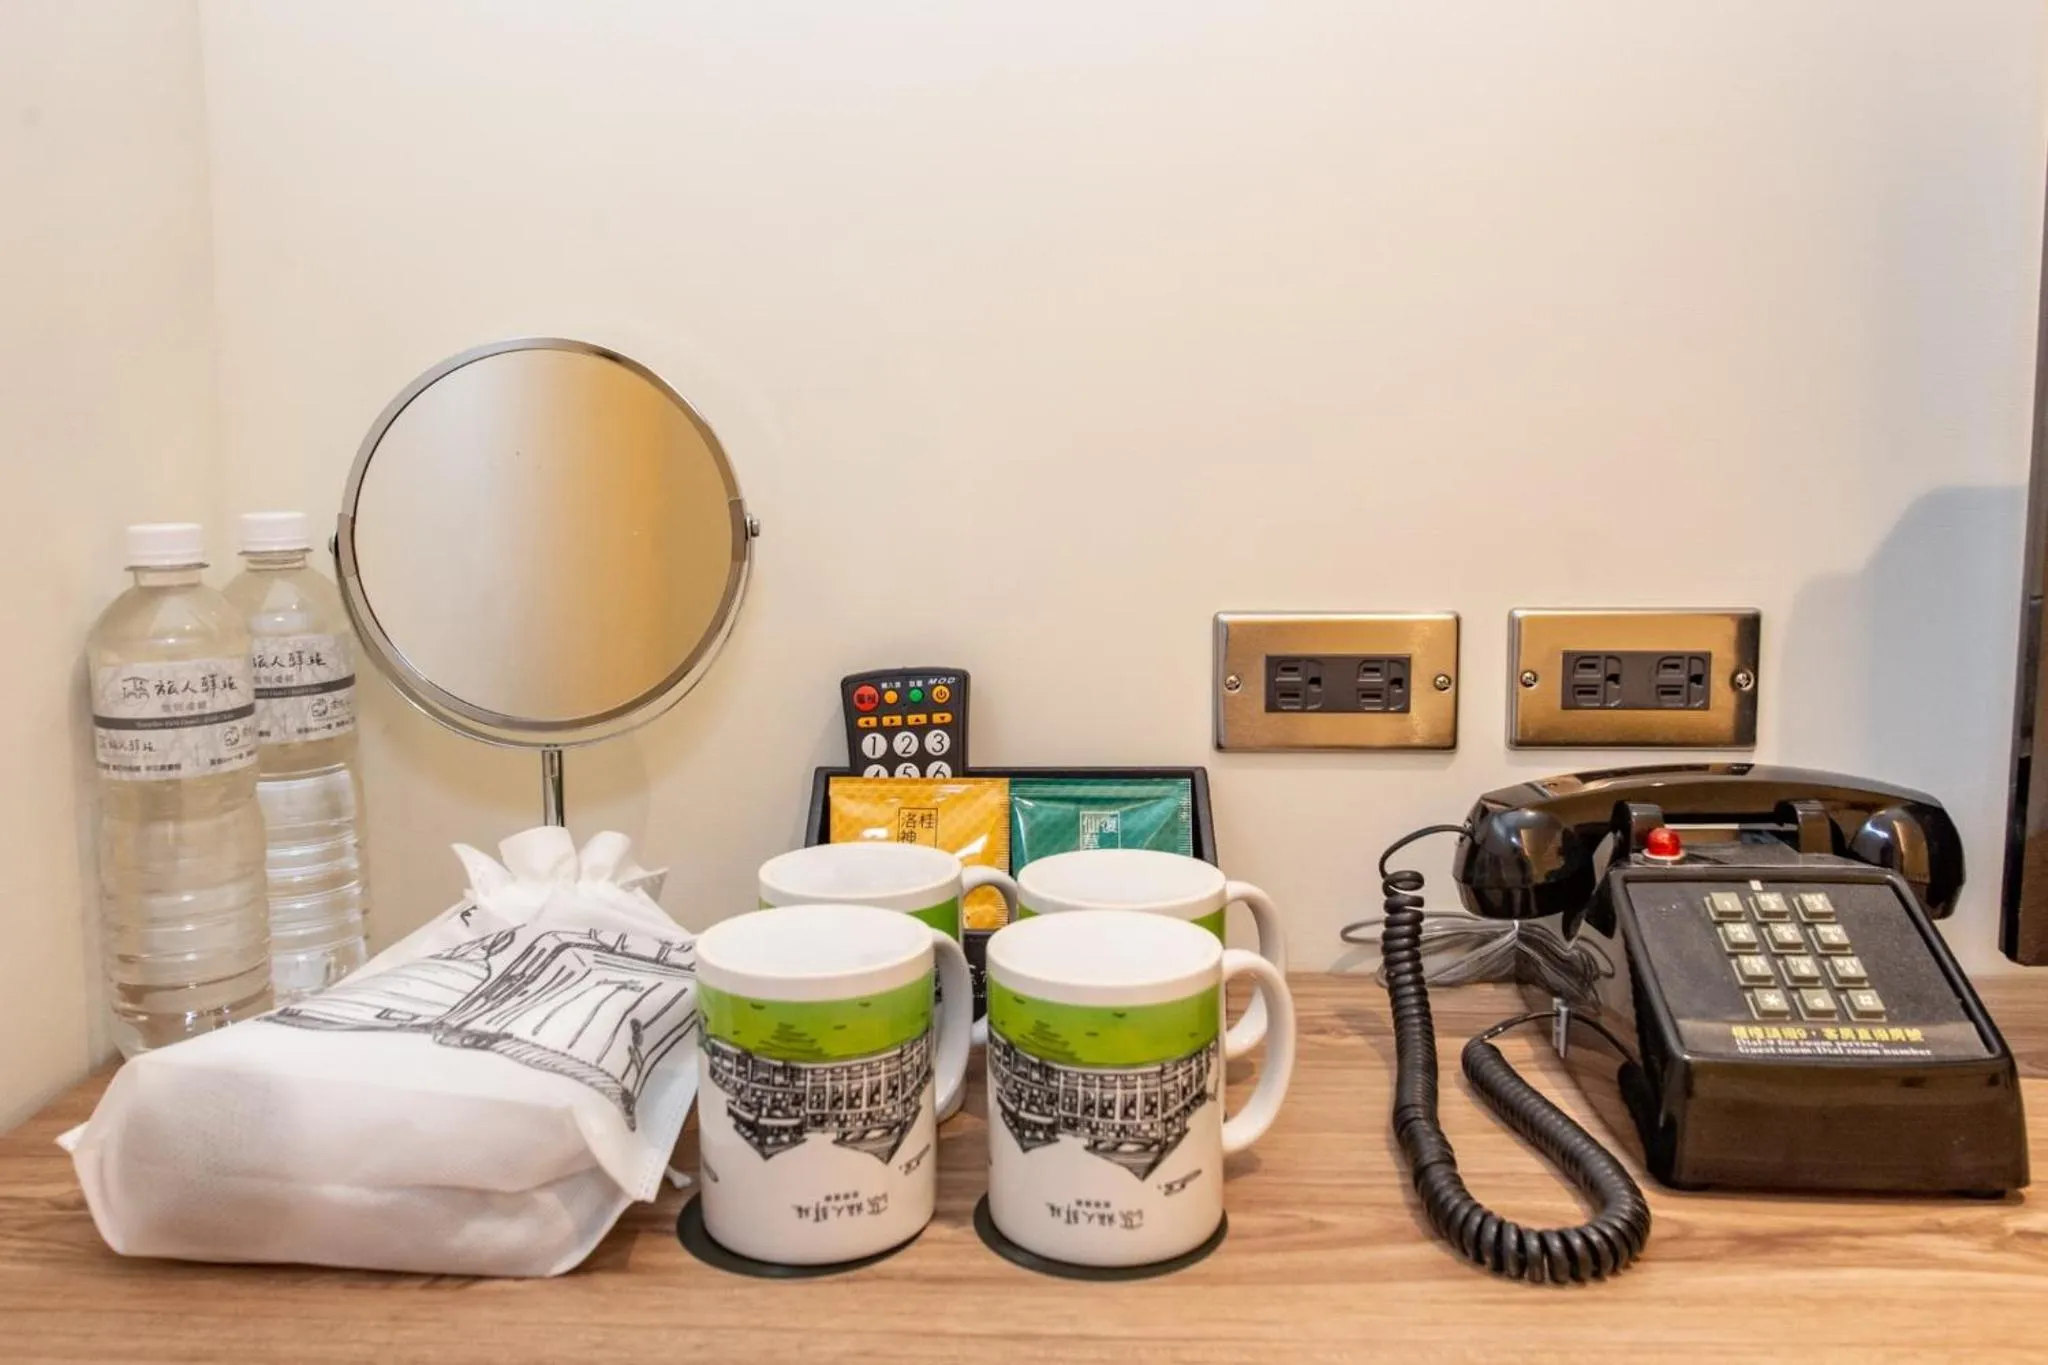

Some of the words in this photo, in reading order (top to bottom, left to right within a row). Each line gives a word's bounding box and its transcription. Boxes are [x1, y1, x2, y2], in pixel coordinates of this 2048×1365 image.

[928, 676, 956, 685] MOD
[871, 736, 877, 756] 1
[901, 735, 913, 755] 2
[931, 733, 944, 753] 3
